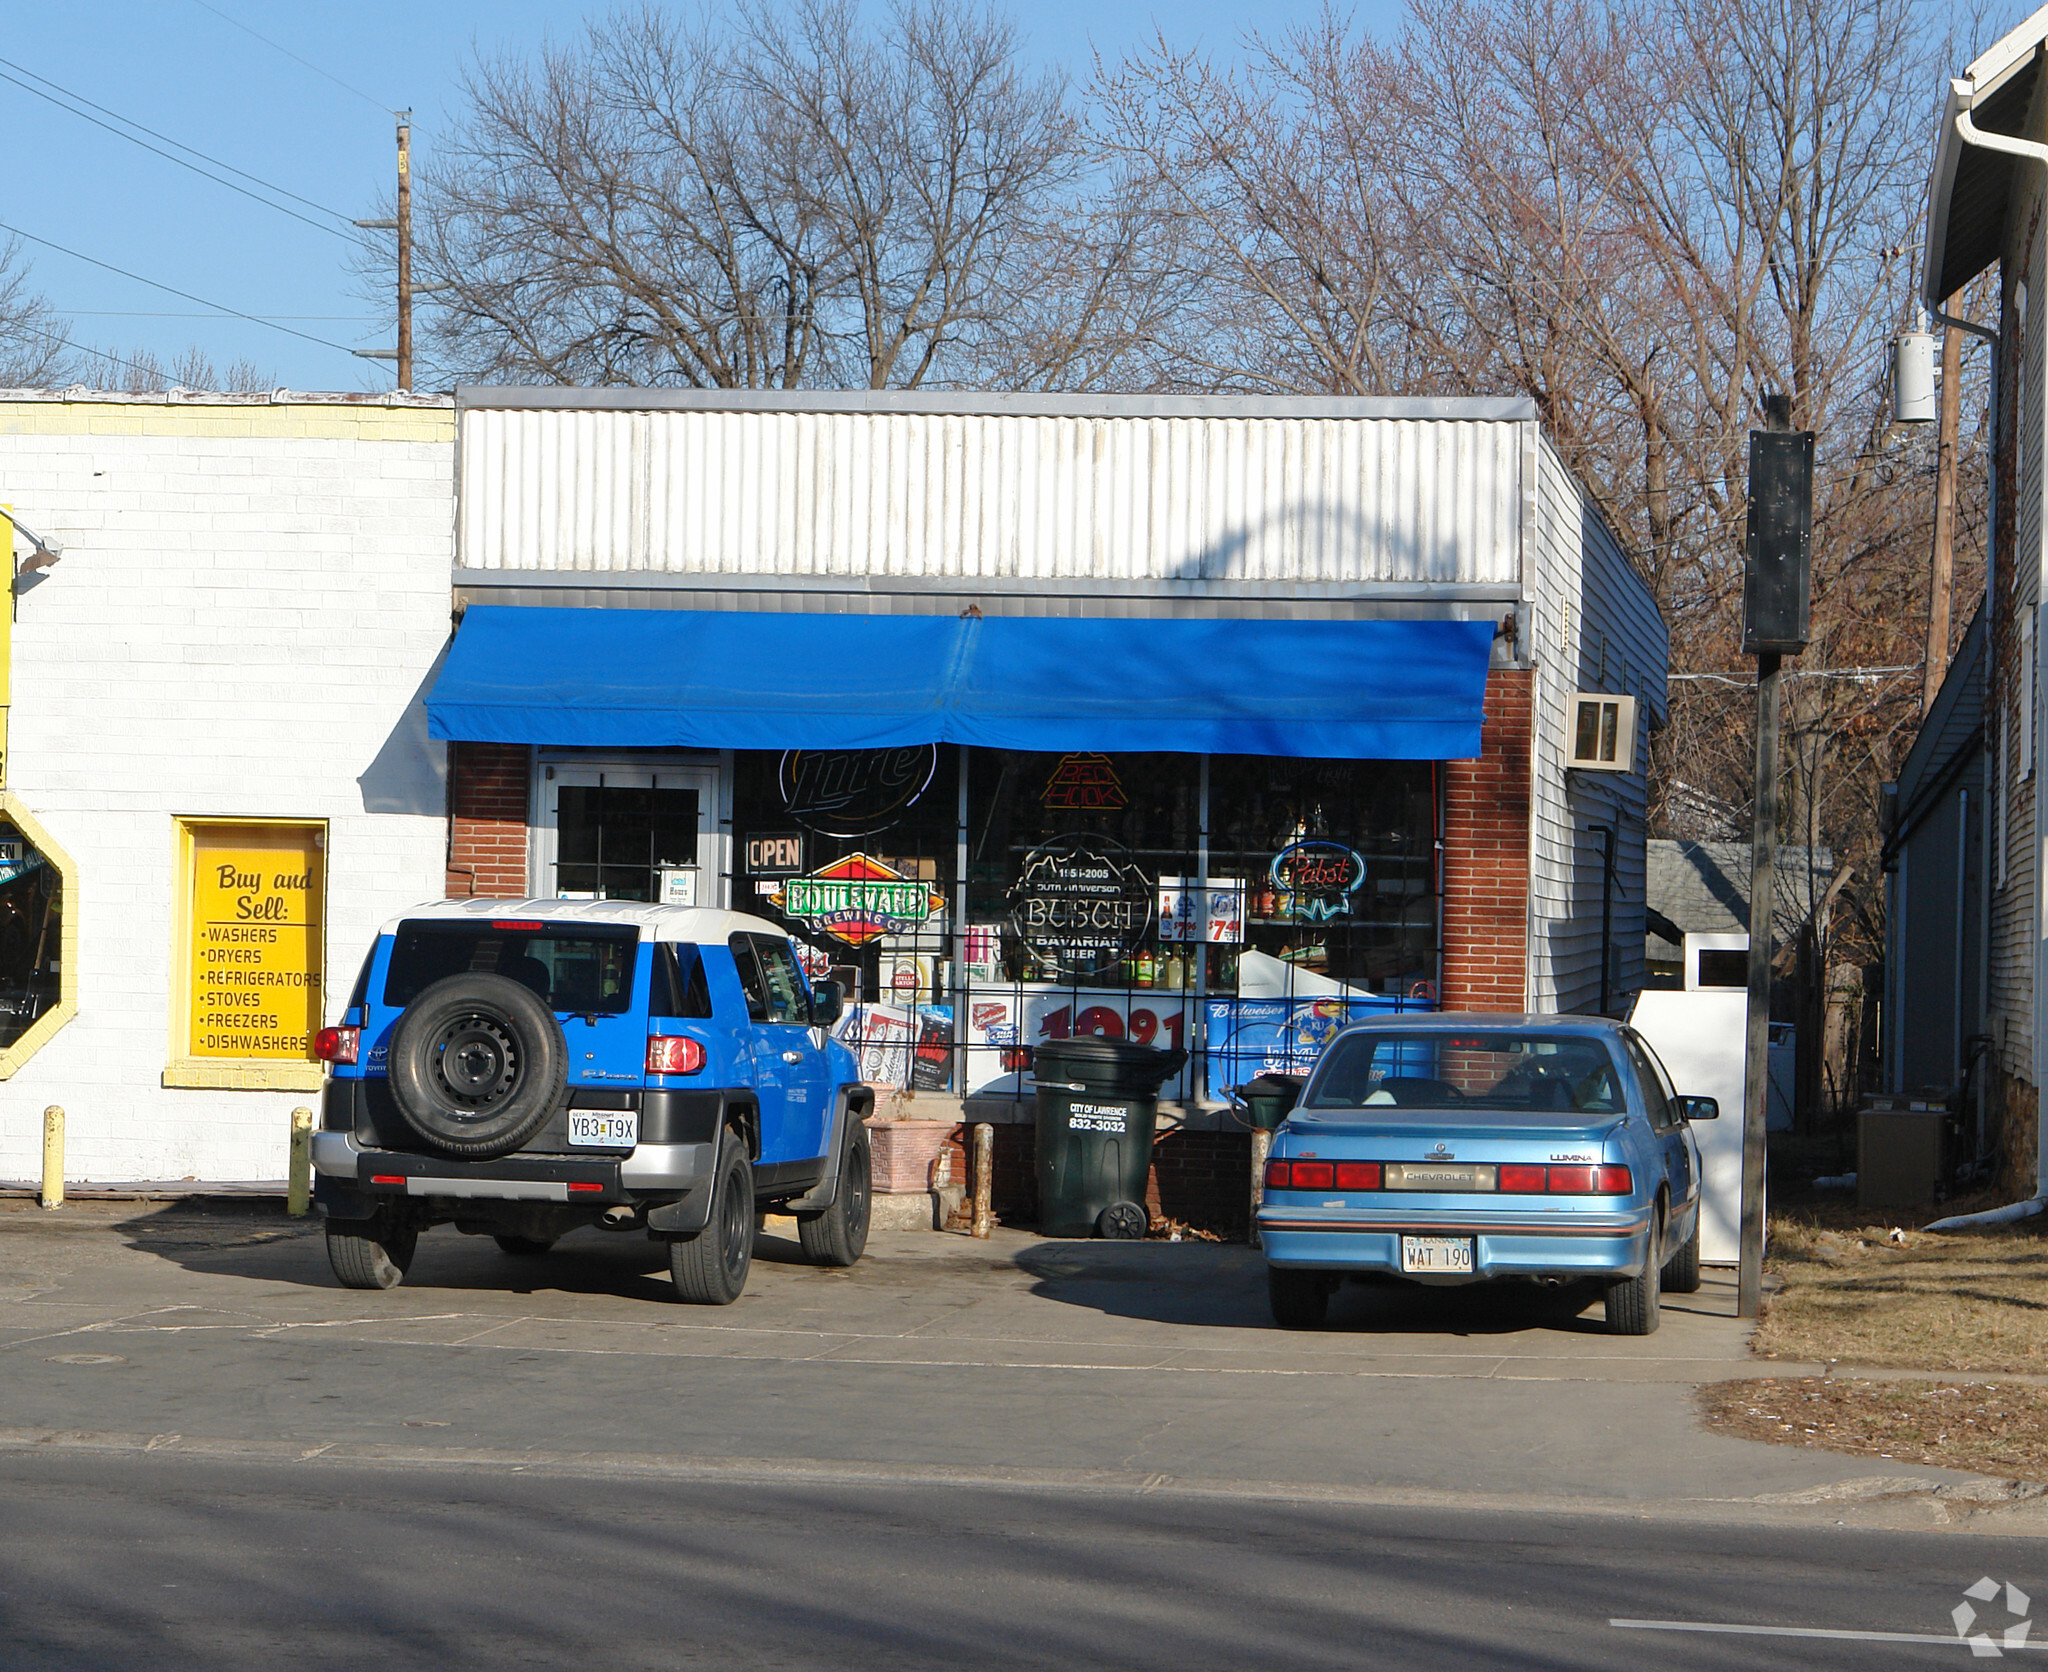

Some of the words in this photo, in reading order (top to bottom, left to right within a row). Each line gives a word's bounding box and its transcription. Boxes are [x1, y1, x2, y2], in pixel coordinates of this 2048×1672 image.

[1058, 765, 1112, 783] RED
[1046, 786, 1124, 805] HOOK
[0, 844, 15, 859] EN
[750, 839, 800, 866] OPEN
[1288, 856, 1350, 885] Pabst
[216, 864, 262, 895] Buy
[273, 867, 313, 890] and
[236, 895, 289, 920] Sell:
[791, 885, 924, 914] BOULEVARD
[813, 911, 883, 930] BREWING
[1024, 898, 1132, 930] BUSCH
[208, 928, 278, 943] WASHERS
[1036, 934, 1123, 948] BAVARIAN
[207, 948, 262, 963] DRYERS
[1062, 948, 1096, 959] BEER
[207, 970, 322, 987] REFRIGERATORS
[207, 992, 260, 1007] STOVES
[1209, 1002, 1286, 1019] Budweiser
[207, 1013, 278, 1029] FREEZERS
[1310, 1021, 1325, 1031] KU
[207, 1034, 308, 1051] DISHWASHERS
[1070, 1103, 1084, 1113] CITY
[1084, 1104, 1093, 1114] OF
[1093, 1105, 1127, 1117] LAWRENCE
[572, 1118, 599, 1137] YB3
[607, 1119, 633, 1139] T9X
[1069, 1117, 1126, 1133] 832-3032
[1549, 1153, 1593, 1162] LUMINA
[1406, 1173, 1475, 1182] CHEVROLET
[1407, 1247, 1434, 1266] WAT
[1445, 1247, 1470, 1266] 190
